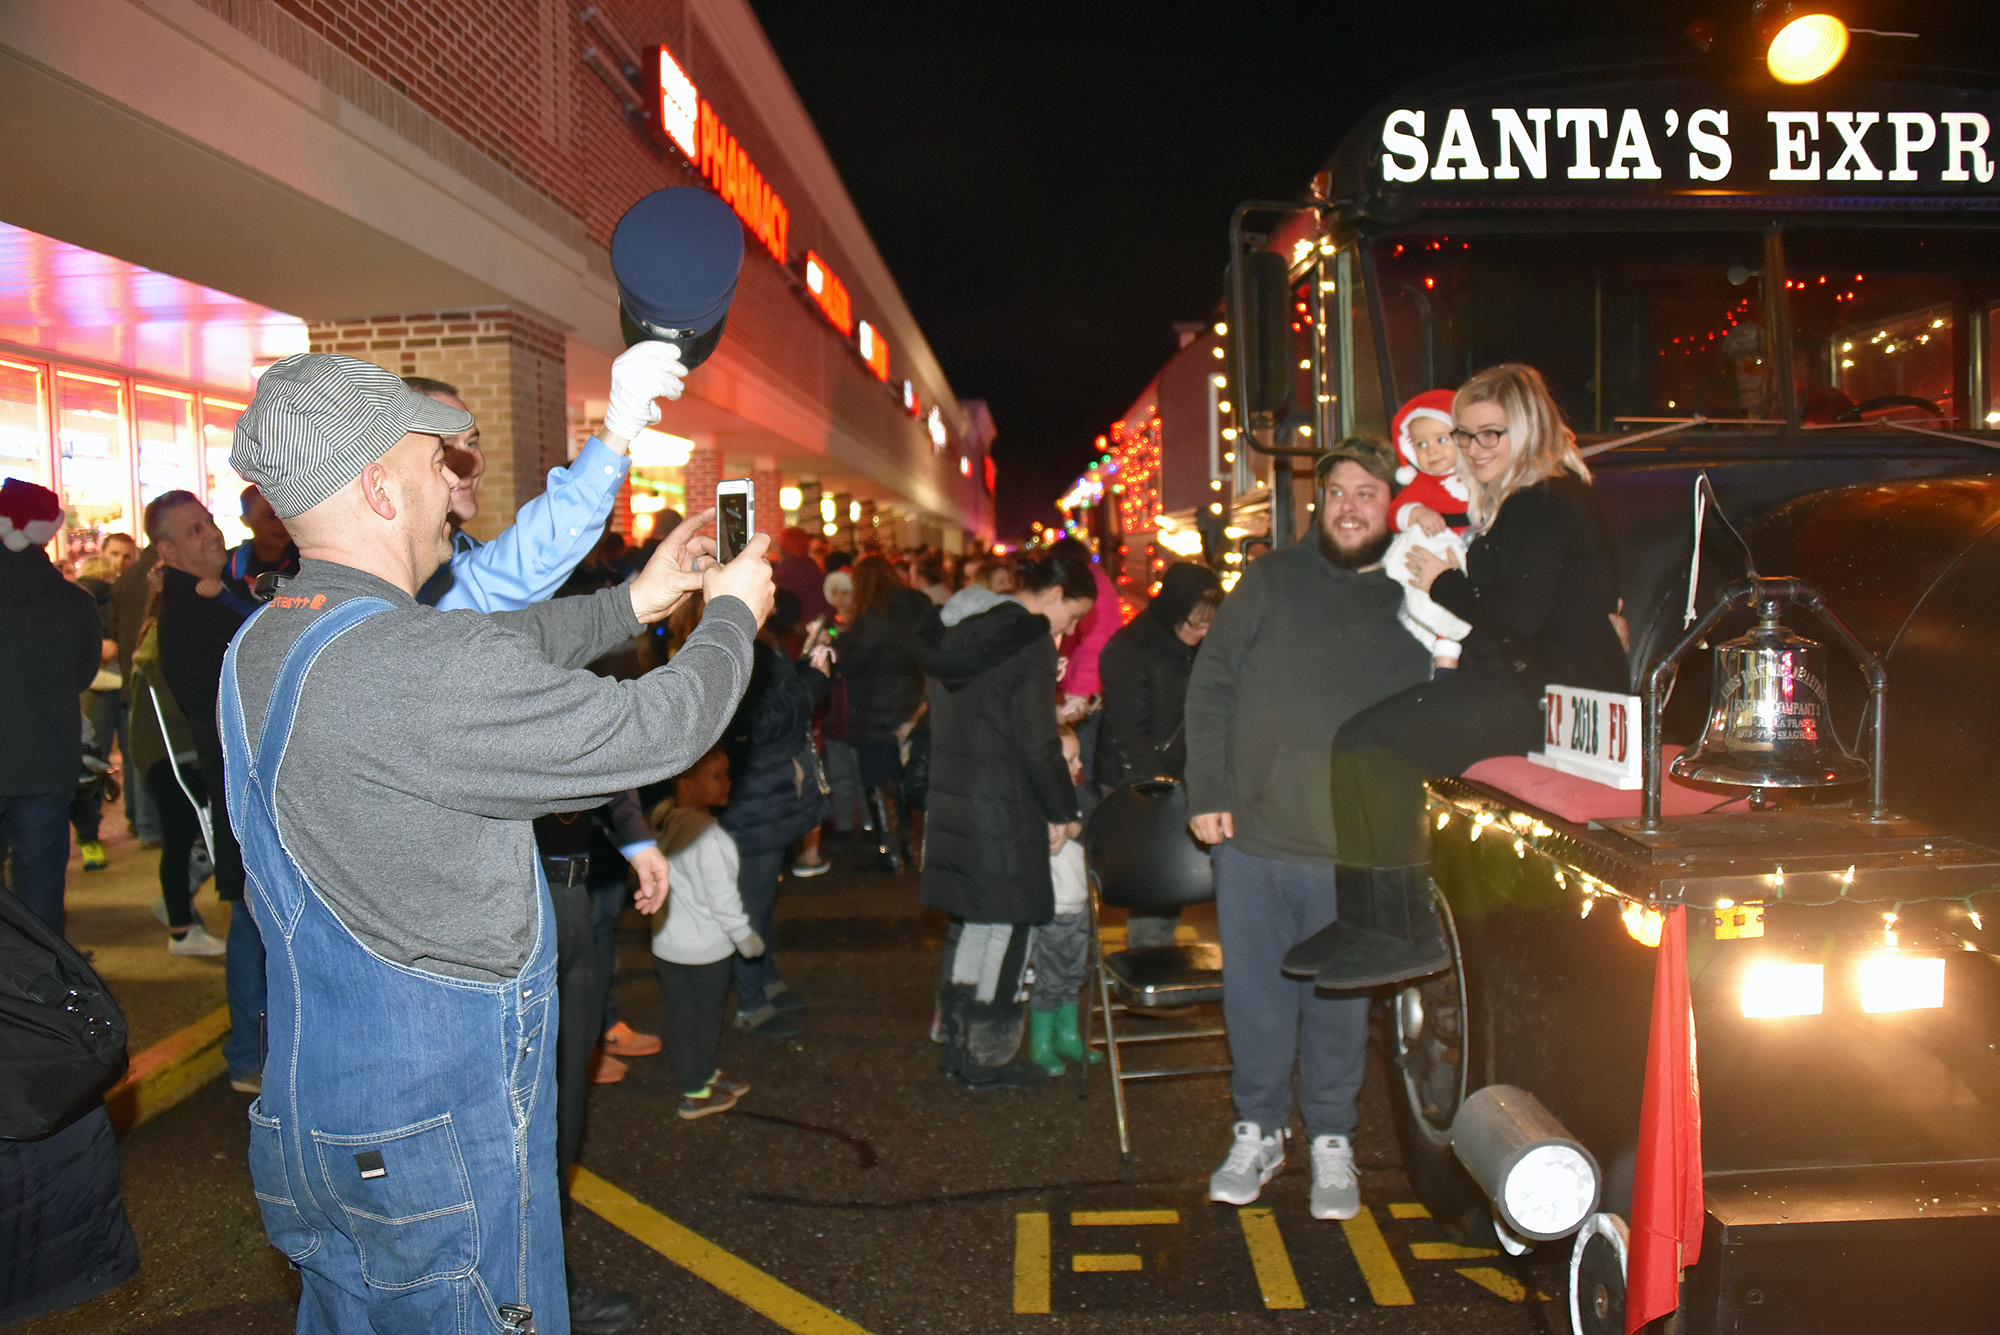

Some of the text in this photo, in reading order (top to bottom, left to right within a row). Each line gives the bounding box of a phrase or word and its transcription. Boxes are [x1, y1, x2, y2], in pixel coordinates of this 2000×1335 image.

[701, 99, 789, 265] PHARMACY
[1382, 108, 1996, 184] SANTA'S EXPR
[1547, 692, 1627, 762] KP 2018 FD
